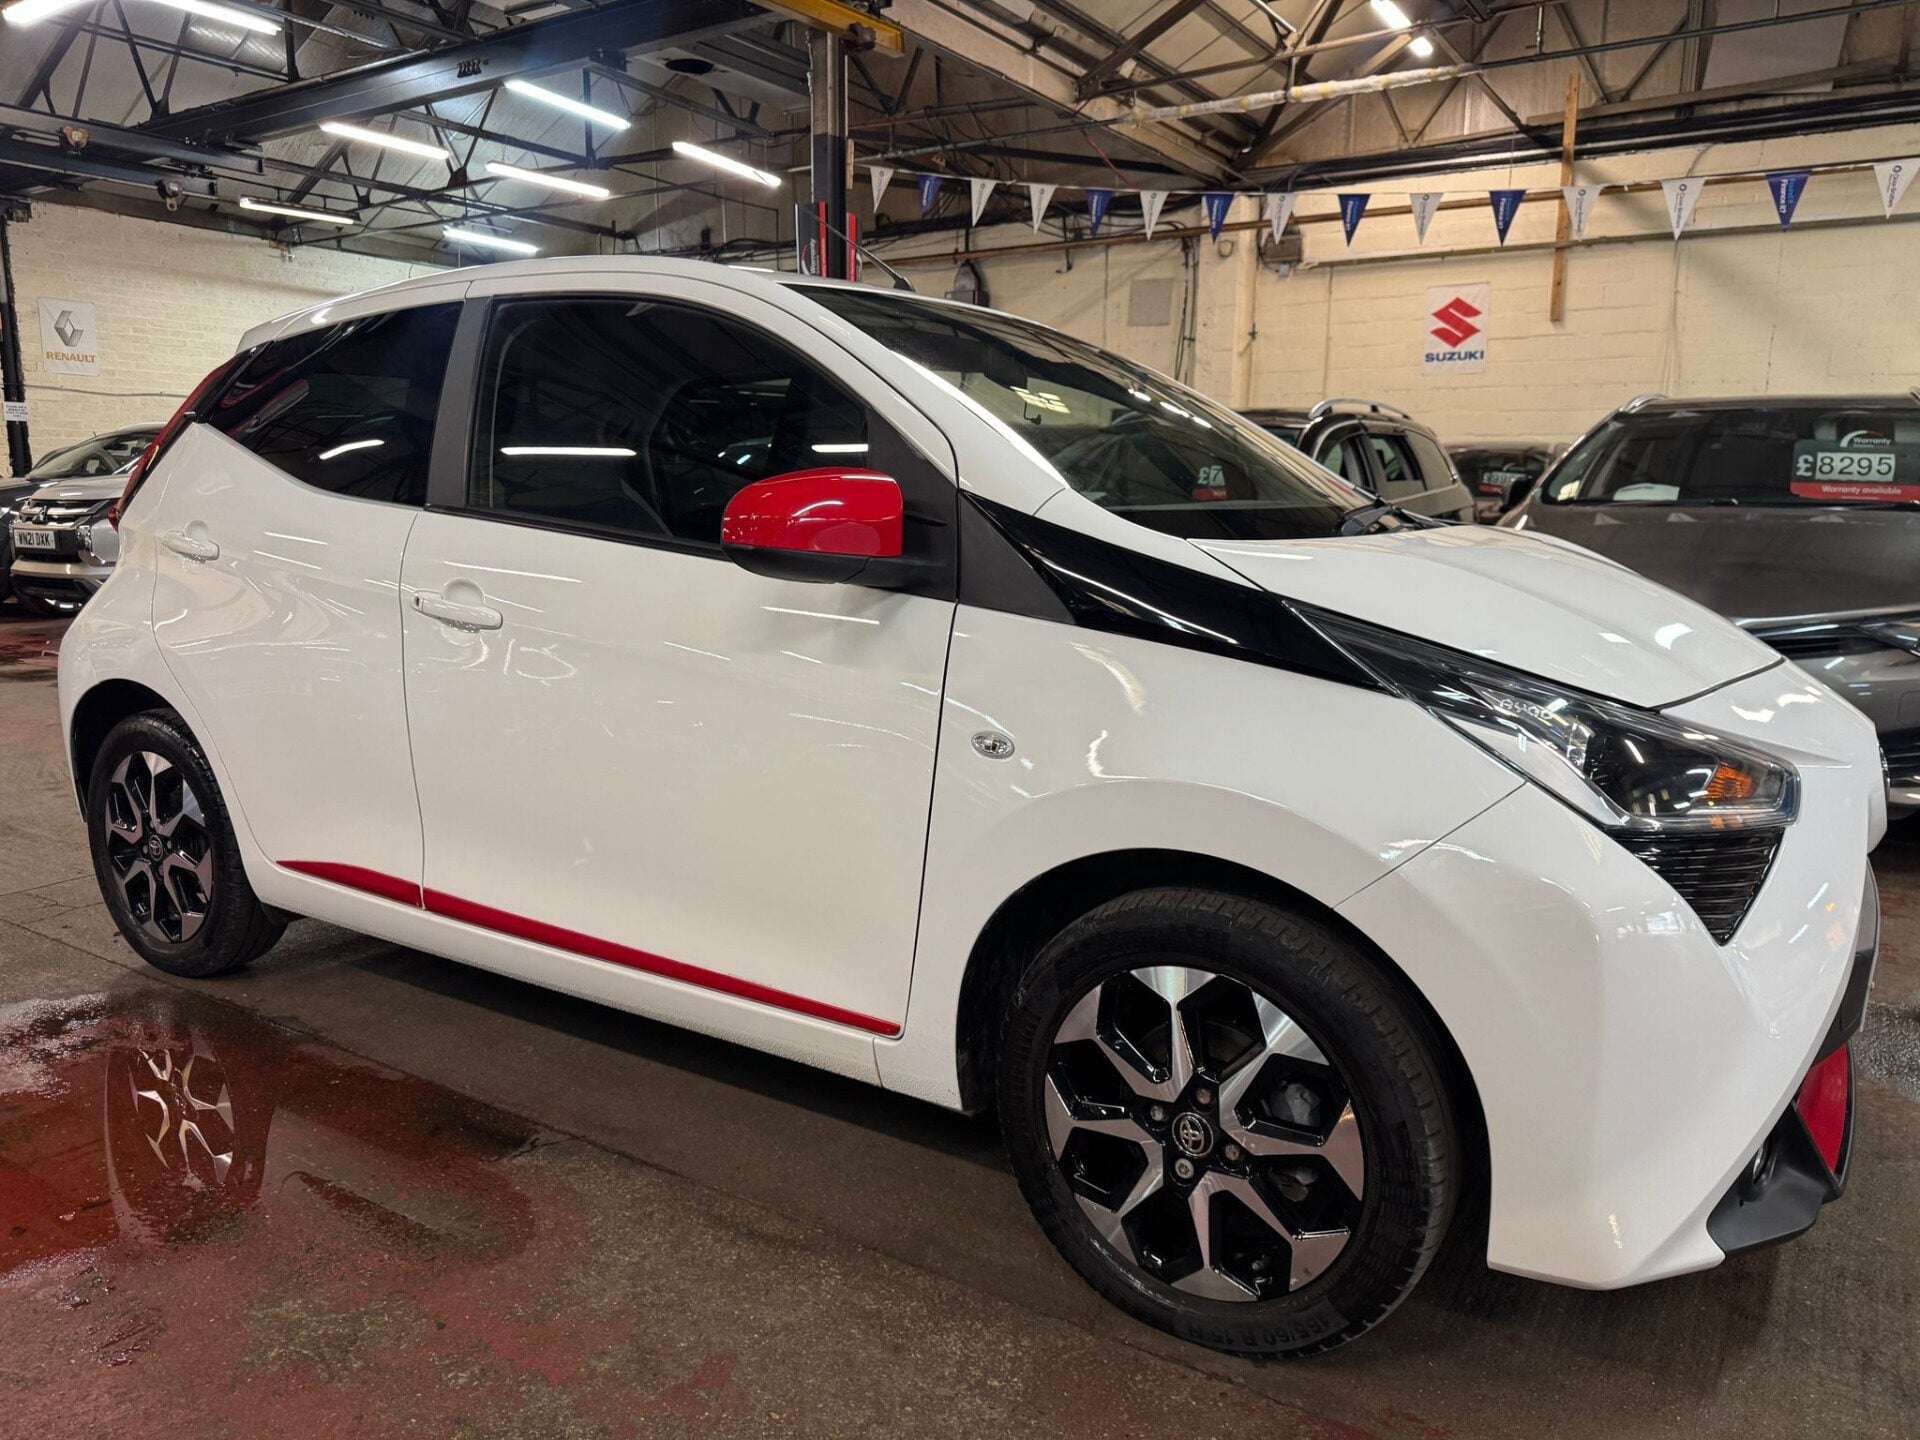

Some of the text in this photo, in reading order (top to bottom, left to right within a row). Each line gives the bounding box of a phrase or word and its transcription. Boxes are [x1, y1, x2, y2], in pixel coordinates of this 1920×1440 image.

[46, 351, 97, 363] RENAULT
[1425, 350, 1485, 362] SUZUKI
[1853, 437, 1892, 446] Warranty
[1795, 454, 1892, 476] £8295
[1822, 484, 1902, 495] Warranty available
[18, 531, 51, 546] WN21 DXK
